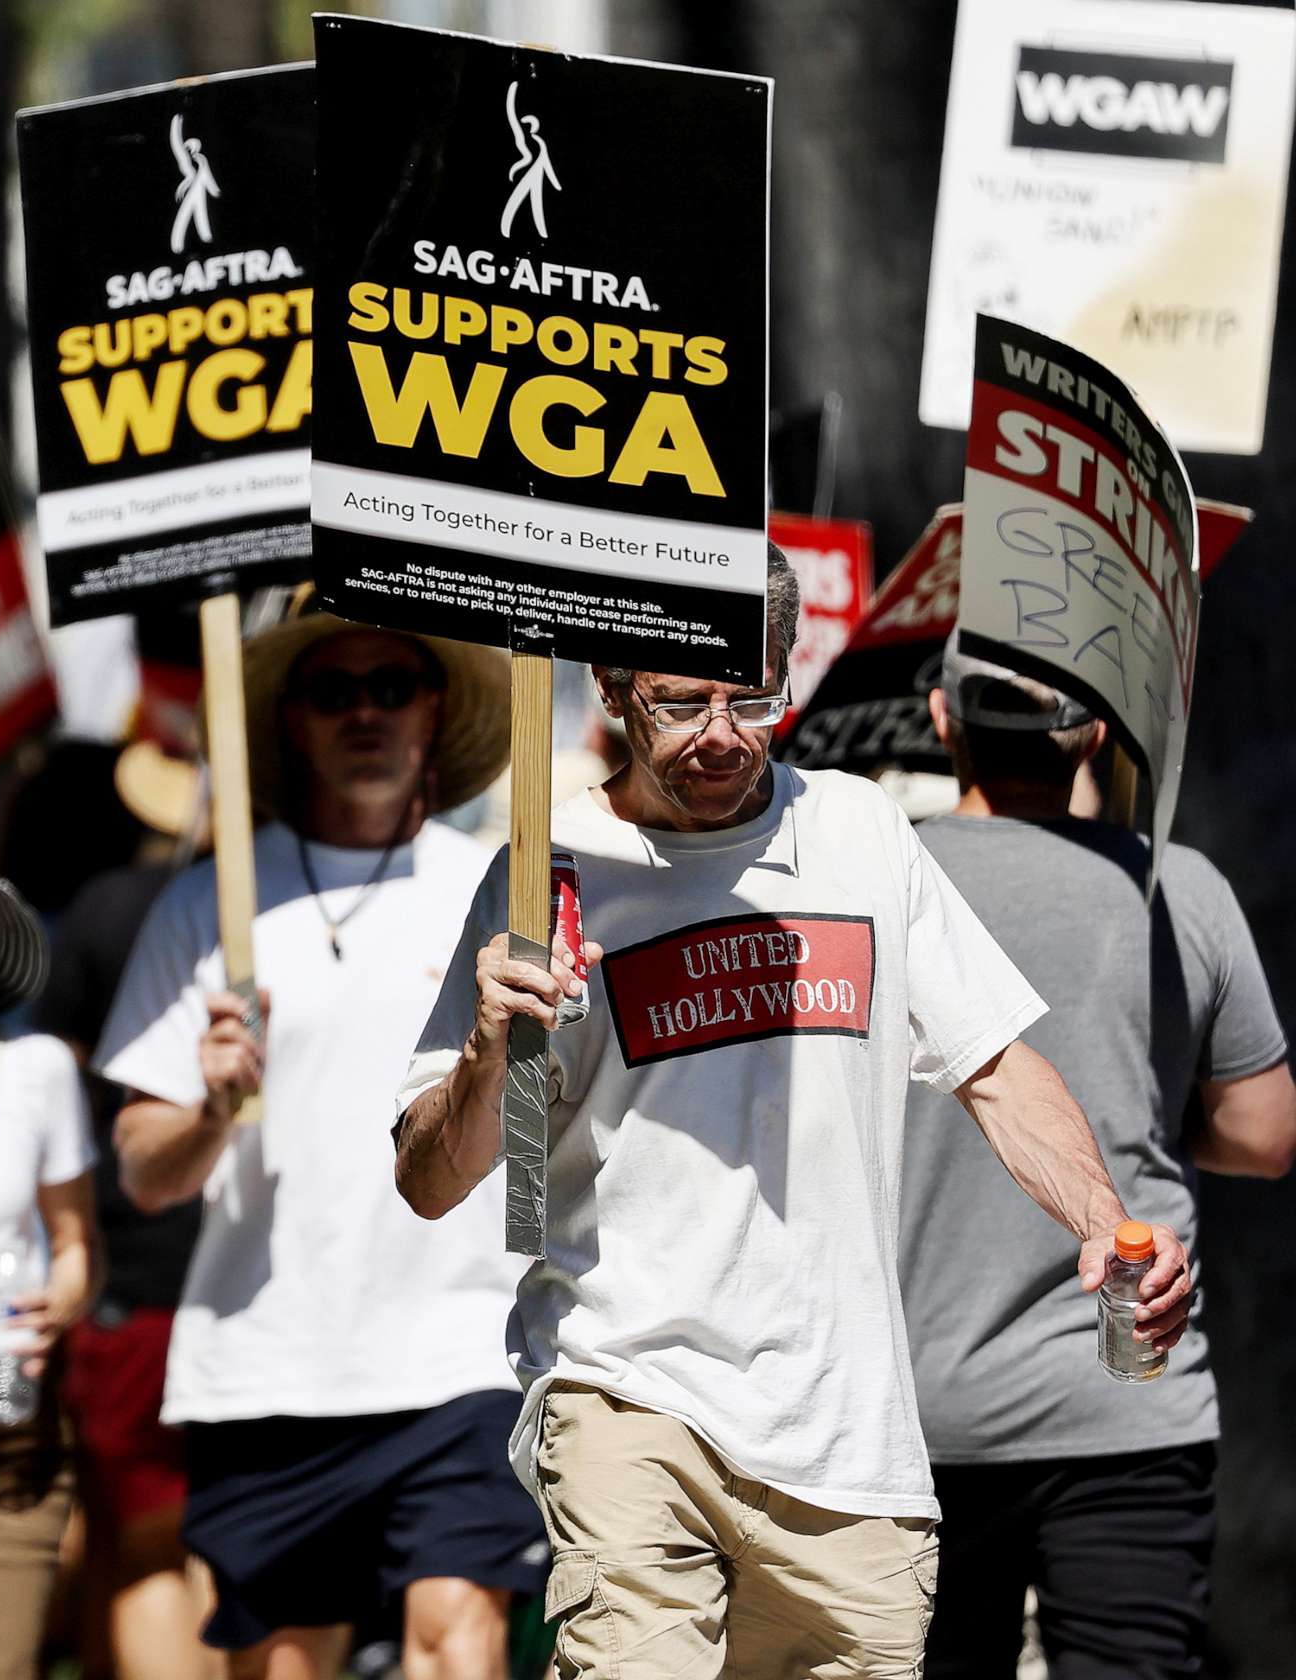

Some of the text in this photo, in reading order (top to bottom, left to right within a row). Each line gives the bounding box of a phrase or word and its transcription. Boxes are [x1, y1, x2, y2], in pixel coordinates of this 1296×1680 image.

[1015, 70, 1230, 138] WGAW
[58, 288, 313, 375] SUPPORT
[348, 282, 728, 386] SUPPORTS
[348, 341, 727, 498] WGA
[1001, 343, 1157, 479] WRITERS
[1127, 459, 1150, 500] ON
[344, 492, 730, 567] Acting Together for a Better Future
[344, 578, 728, 647] services, or to refuse to pick up, deliver, handle or transport any goods.
[361, 567, 711, 633] SAG-AFTRA is not asking any individual to cease performing any
[406, 563, 664, 613] No dispute with any other employer at this site.
[997, 508, 1162, 664] GREE
[681, 931, 810, 979] UNITED
[647, 978, 856, 1039] HOLLYWOOD
